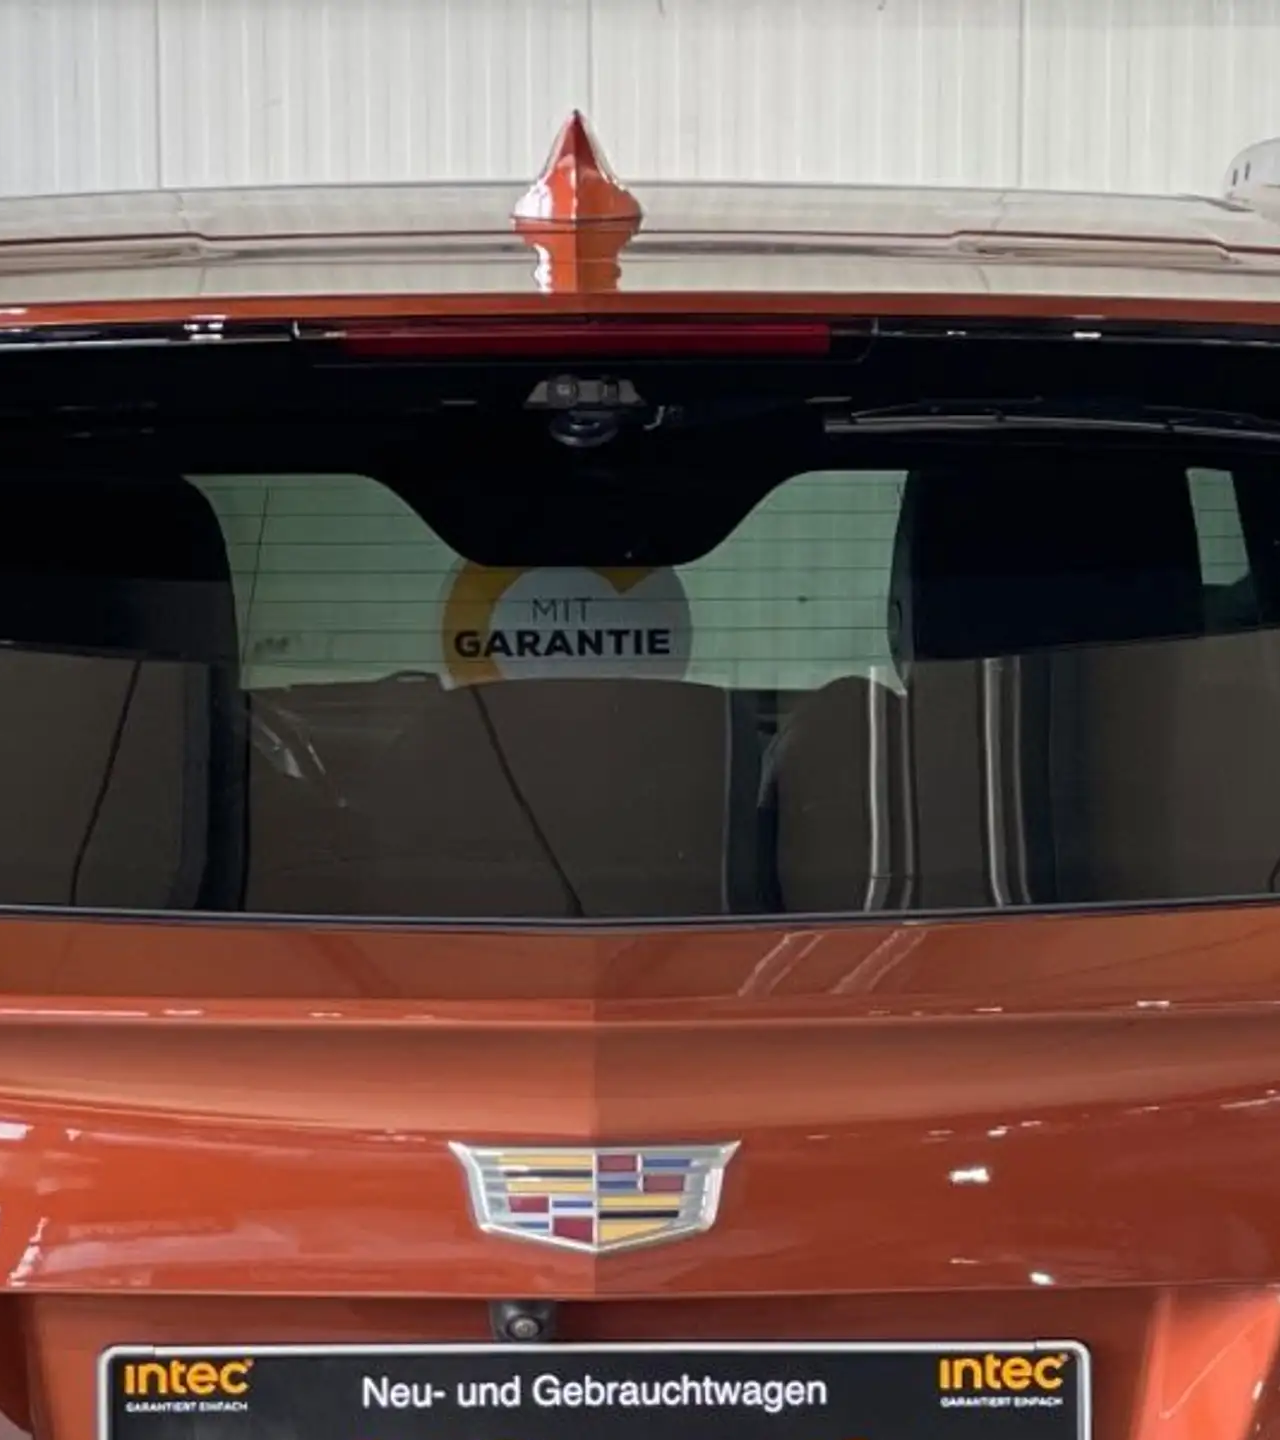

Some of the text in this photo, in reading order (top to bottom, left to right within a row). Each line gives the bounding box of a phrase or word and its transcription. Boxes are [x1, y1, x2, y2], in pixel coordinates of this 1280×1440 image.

[530, 596, 594, 623] MIT
[453, 629, 672, 658] GARANTIE
[362, 1374, 828, 1412] Neu- und Gebrauchtwagen
